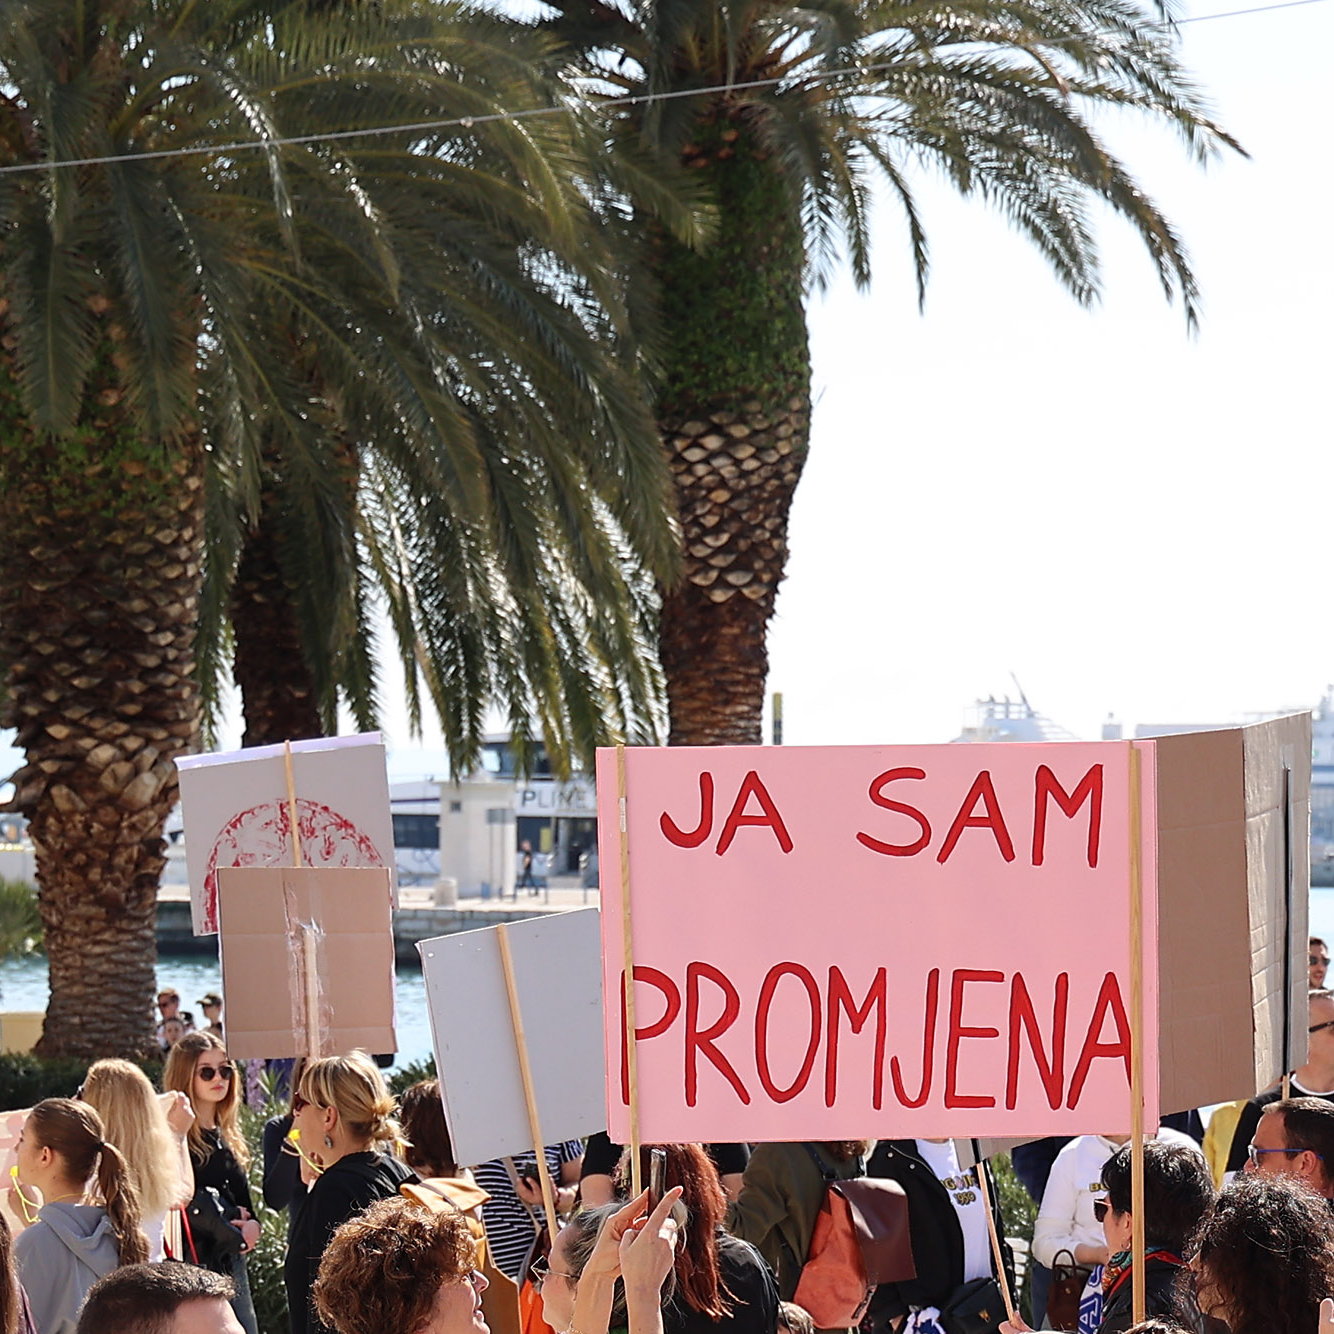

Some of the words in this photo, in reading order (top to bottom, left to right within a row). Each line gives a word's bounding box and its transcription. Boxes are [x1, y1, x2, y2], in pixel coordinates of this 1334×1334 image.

[659, 770, 794, 856] JA
[856, 763, 1104, 869] SAM
[621, 961, 1139, 1111] PROMJENA
